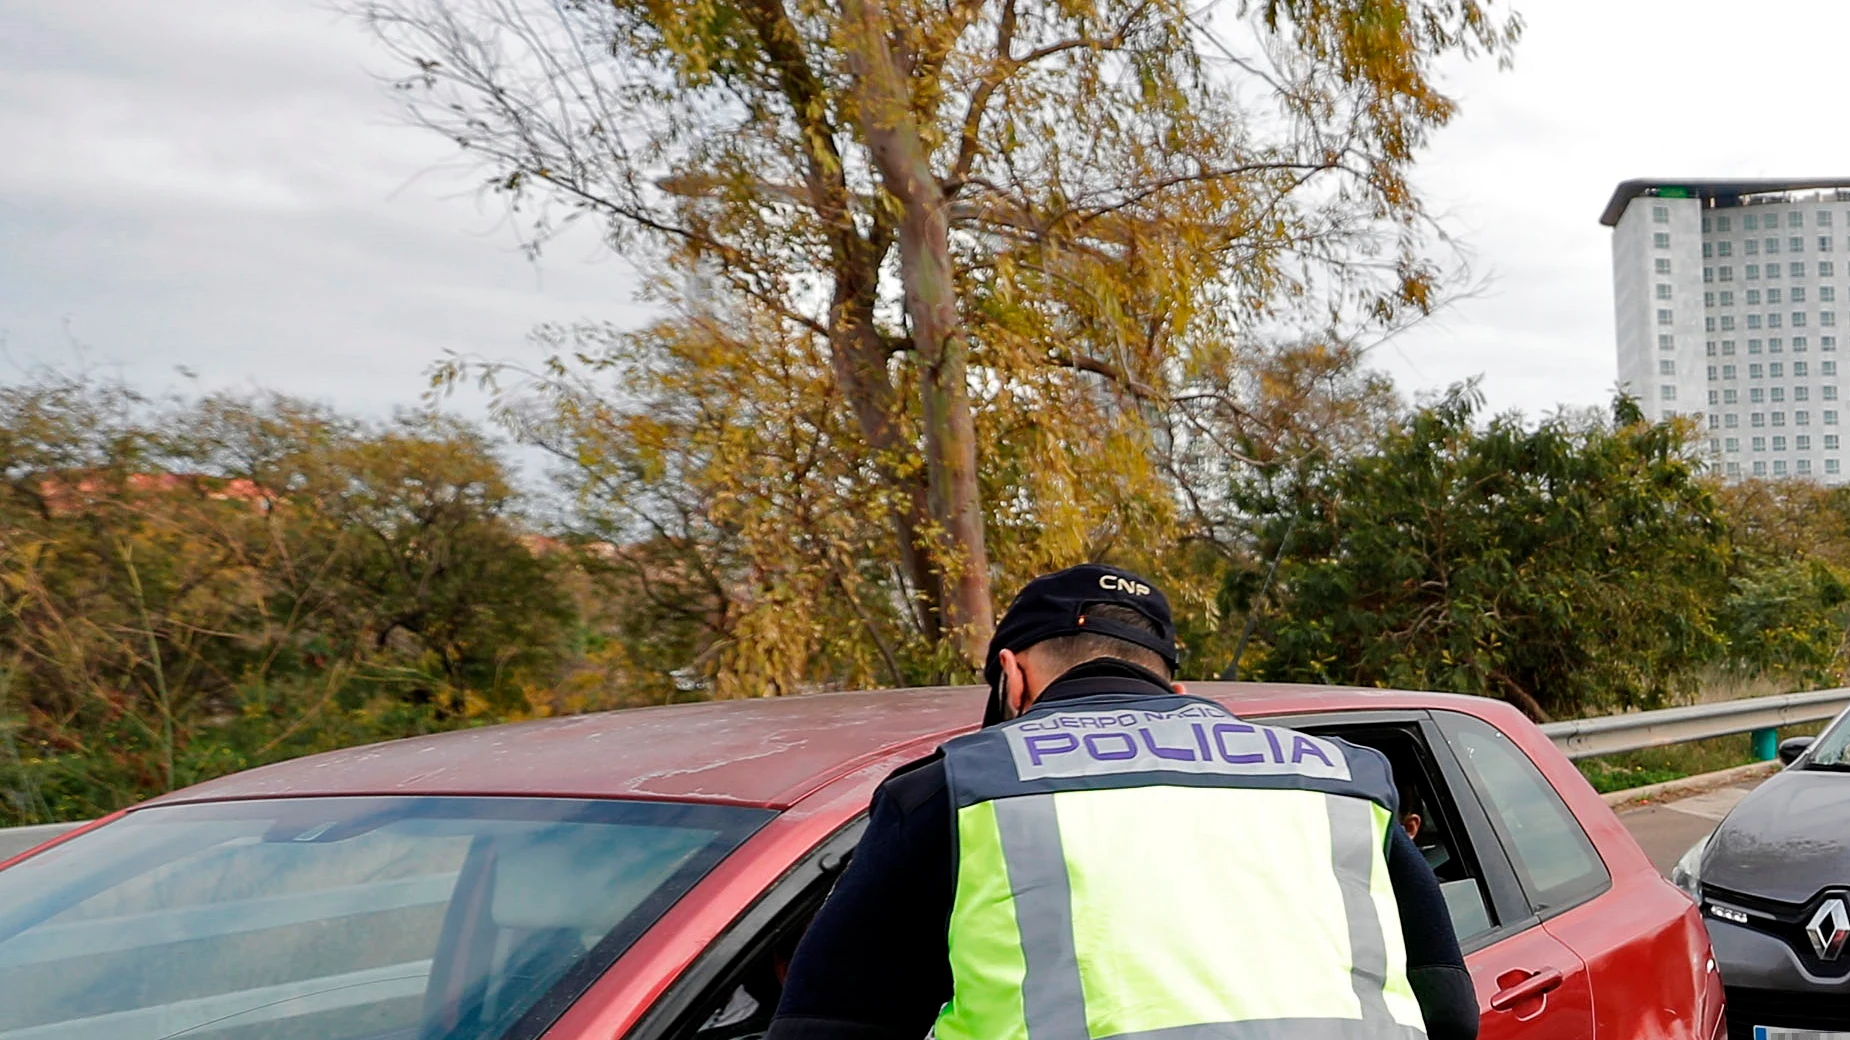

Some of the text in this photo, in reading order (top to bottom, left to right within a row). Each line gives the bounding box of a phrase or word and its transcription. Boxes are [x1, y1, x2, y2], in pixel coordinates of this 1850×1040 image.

[1099, 575, 1151, 596] CNP
[1018, 713, 1137, 733] CUERPO
[1023, 723, 1335, 768] POLICIA
